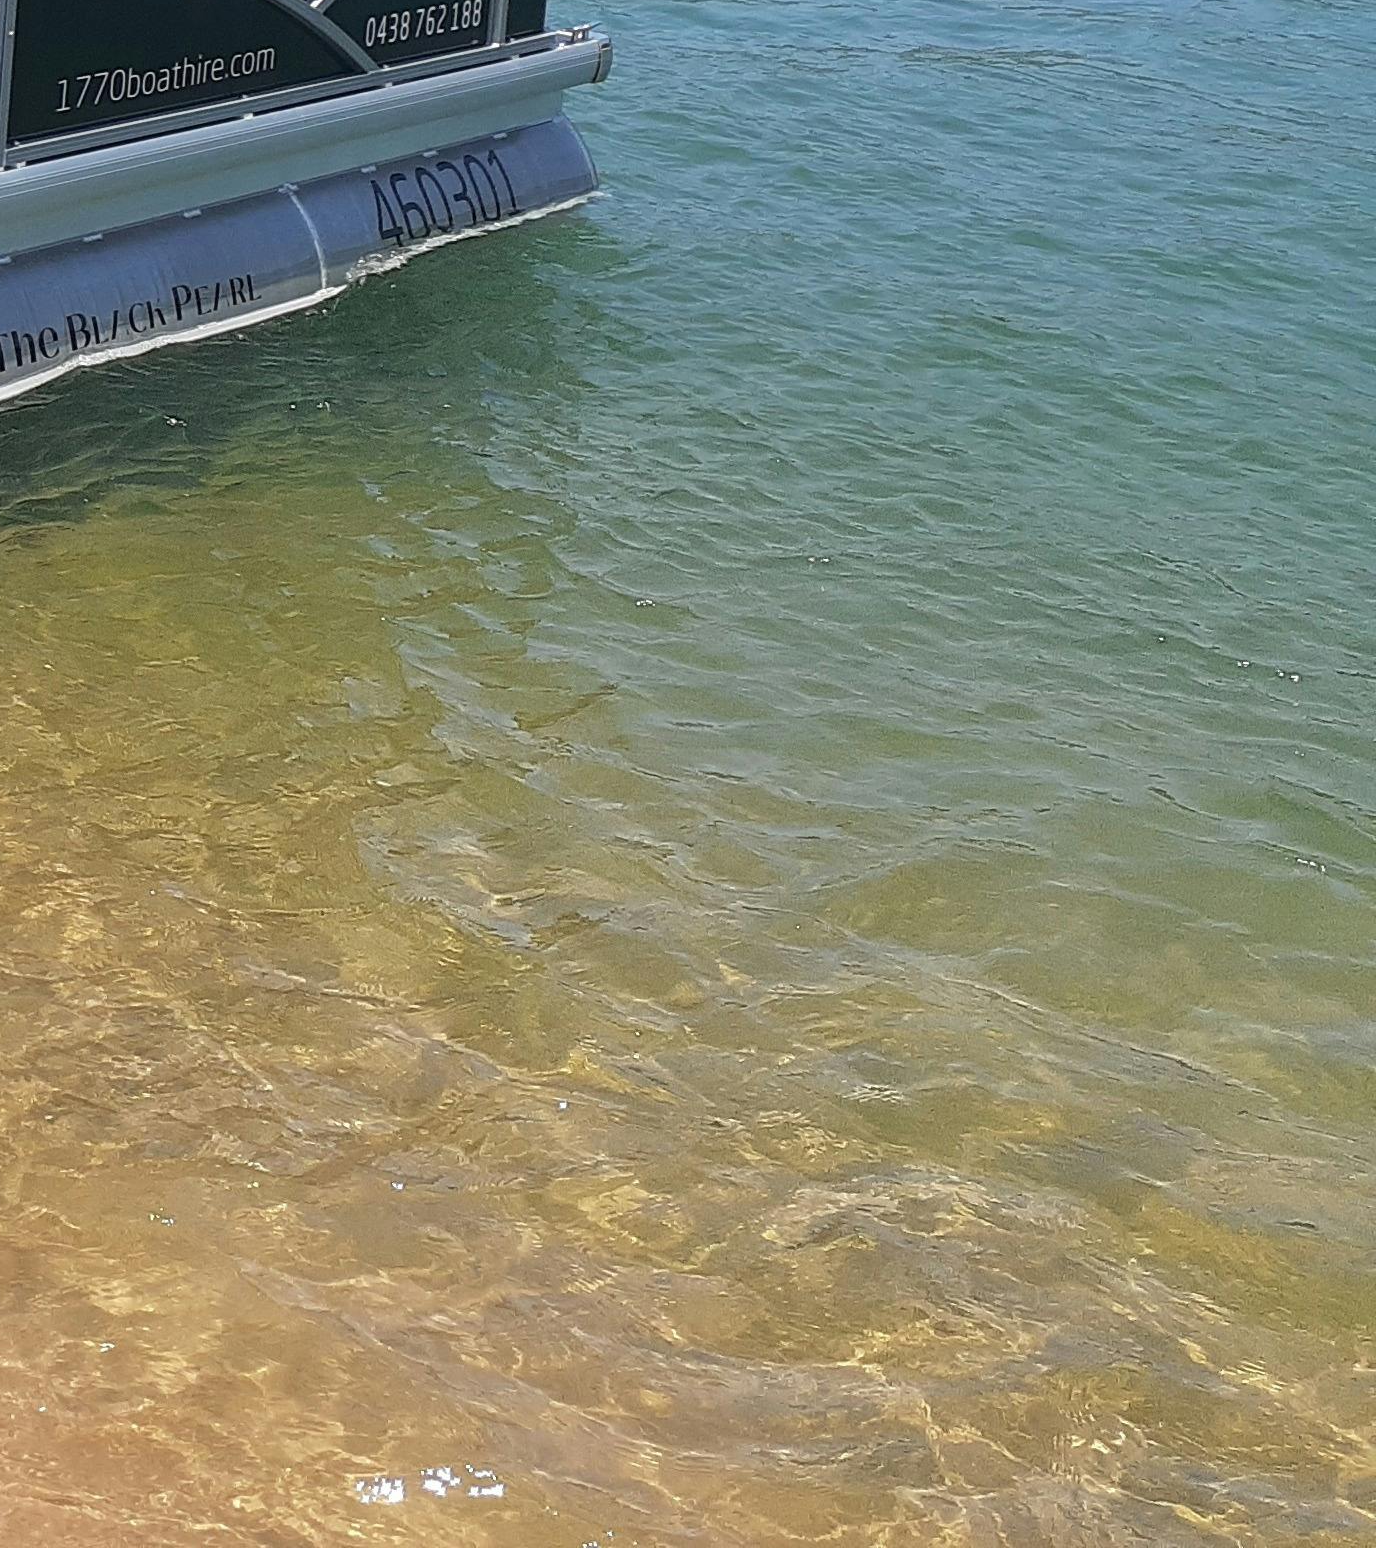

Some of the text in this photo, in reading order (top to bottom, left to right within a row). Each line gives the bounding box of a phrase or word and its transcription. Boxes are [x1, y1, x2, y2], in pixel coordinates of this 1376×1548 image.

[364, 6, 411, 48] 0438
[414, 0, 447, 40] 762
[55, 45, 276, 112] 1770boathire.com
[370, 149, 523, 248] 460301
